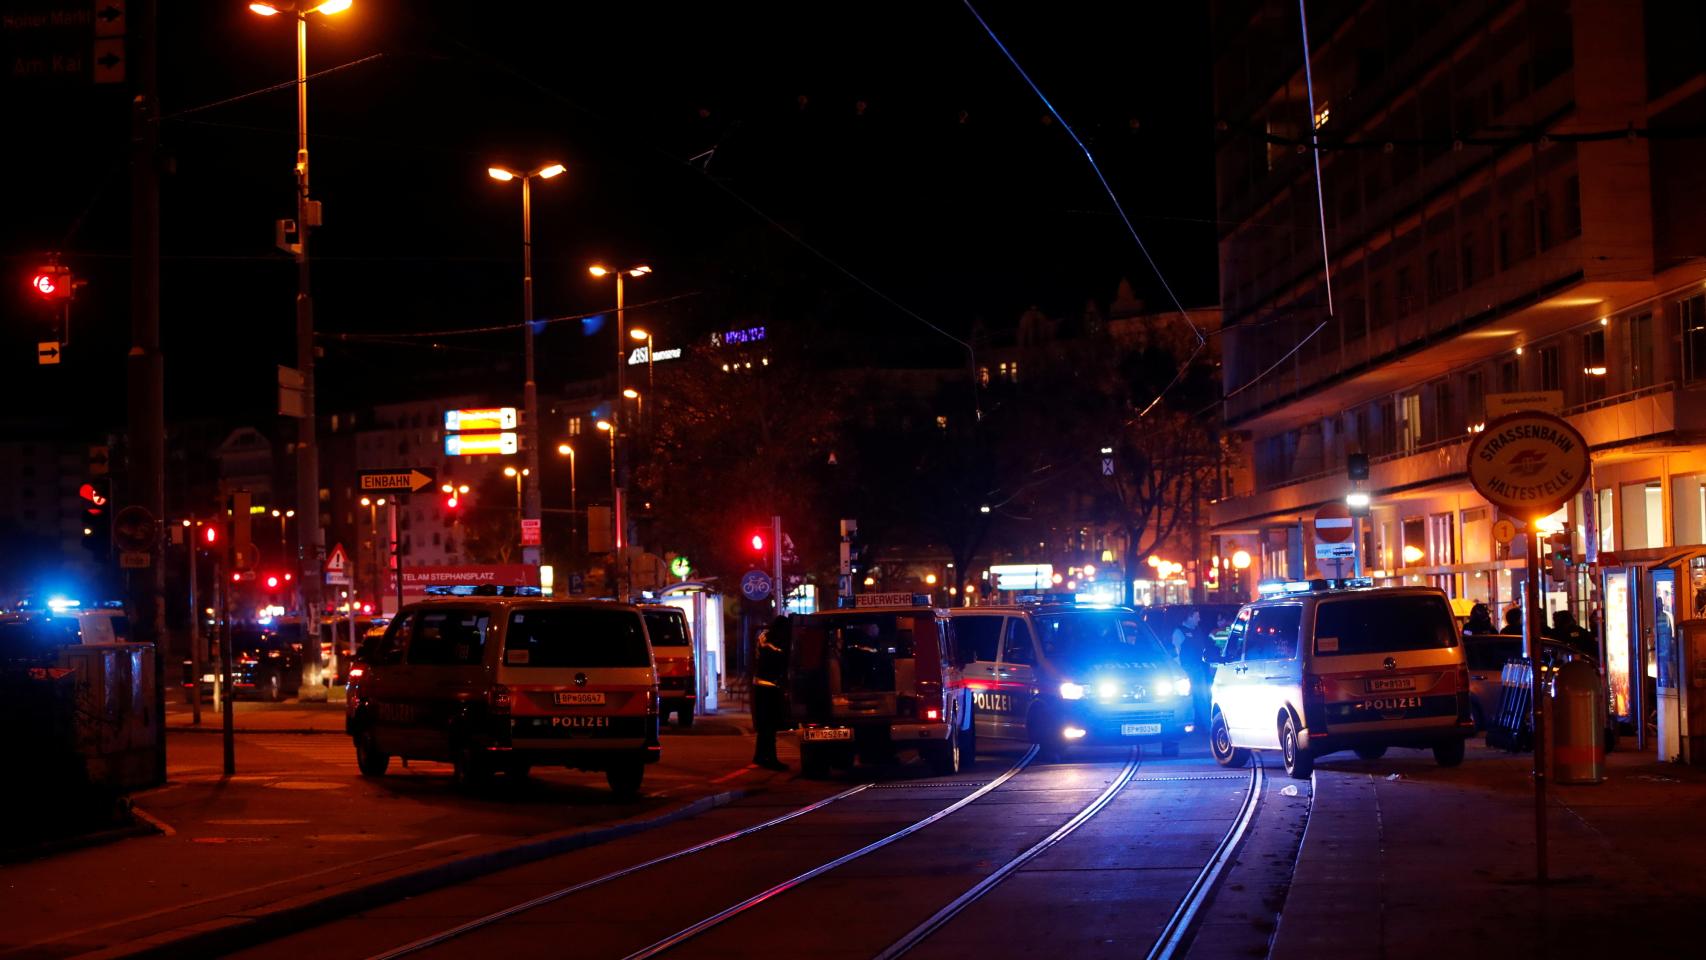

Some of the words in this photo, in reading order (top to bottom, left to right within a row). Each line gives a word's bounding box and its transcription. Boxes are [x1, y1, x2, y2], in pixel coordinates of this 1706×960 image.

[15, 56, 44, 73] Am
[52, 55, 81, 72] Kai
[1480, 424, 1575, 462] STRASSENBAHN
[365, 475, 410, 488] EINBAHN
[1488, 468, 1574, 500] HALTESTELLE
[391, 573, 417, 581] HTEL
[431, 572, 495, 581] STEPHANSPLATZ
[856, 594, 911, 606] FEUERWEHR
[972, 693, 1012, 711] POLIZEI
[1365, 697, 1421, 710] POLIZEI
[552, 717, 609, 727] POLIZEI
